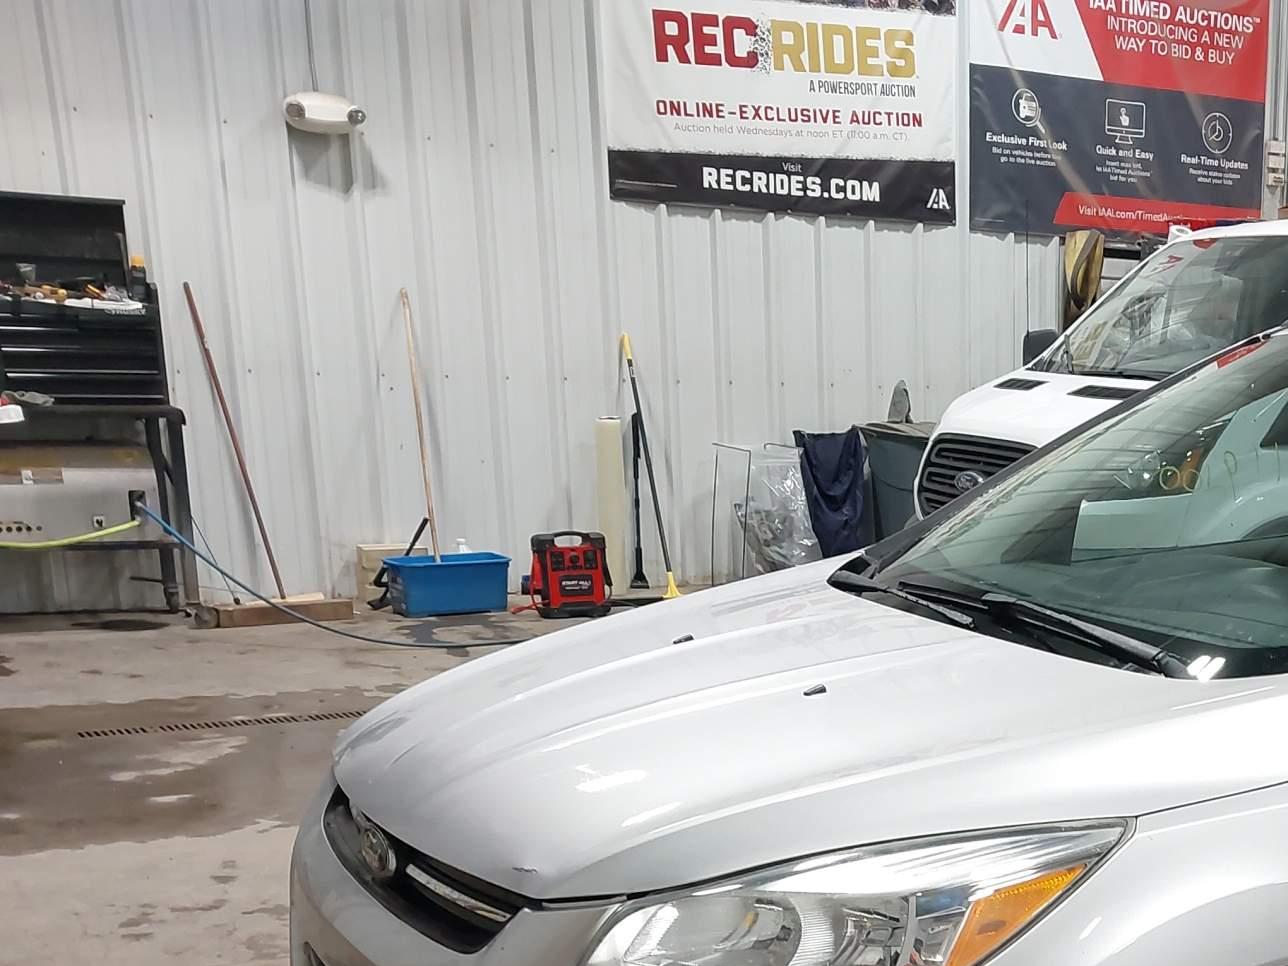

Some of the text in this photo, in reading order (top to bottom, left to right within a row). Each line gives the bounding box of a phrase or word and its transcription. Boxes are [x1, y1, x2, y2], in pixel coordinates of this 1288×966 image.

[1120, 0, 1170, 20] TIMED
[1107, 15, 1244, 49] INTRODUCING A NEW
[652, 9, 916, 79] REC RIDES
[1114, 35, 1235, 65] WAY TO BID & BUY
[809, 80, 916, 98] A POWERSPORT AUCTION
[656, 99, 923, 128] ONLINE-EXCLUSIVE AUCTION
[674, 122, 711, 133] Auction
[713, 124, 734, 134] held
[736, 126, 793, 138] Wednesdays
[832, 130, 844, 139] ET
[985, 131, 1027, 146] Exclusive
[1029, 136, 1047, 148] First
[1096, 144, 1154, 161] Quick and Easy
[1181, 153, 1249, 170] Real-Time Updates
[782, 162, 802, 173] Visit
[702, 166, 881, 202] RECRIDES.COM
[1078, 205, 1097, 216] Visit
